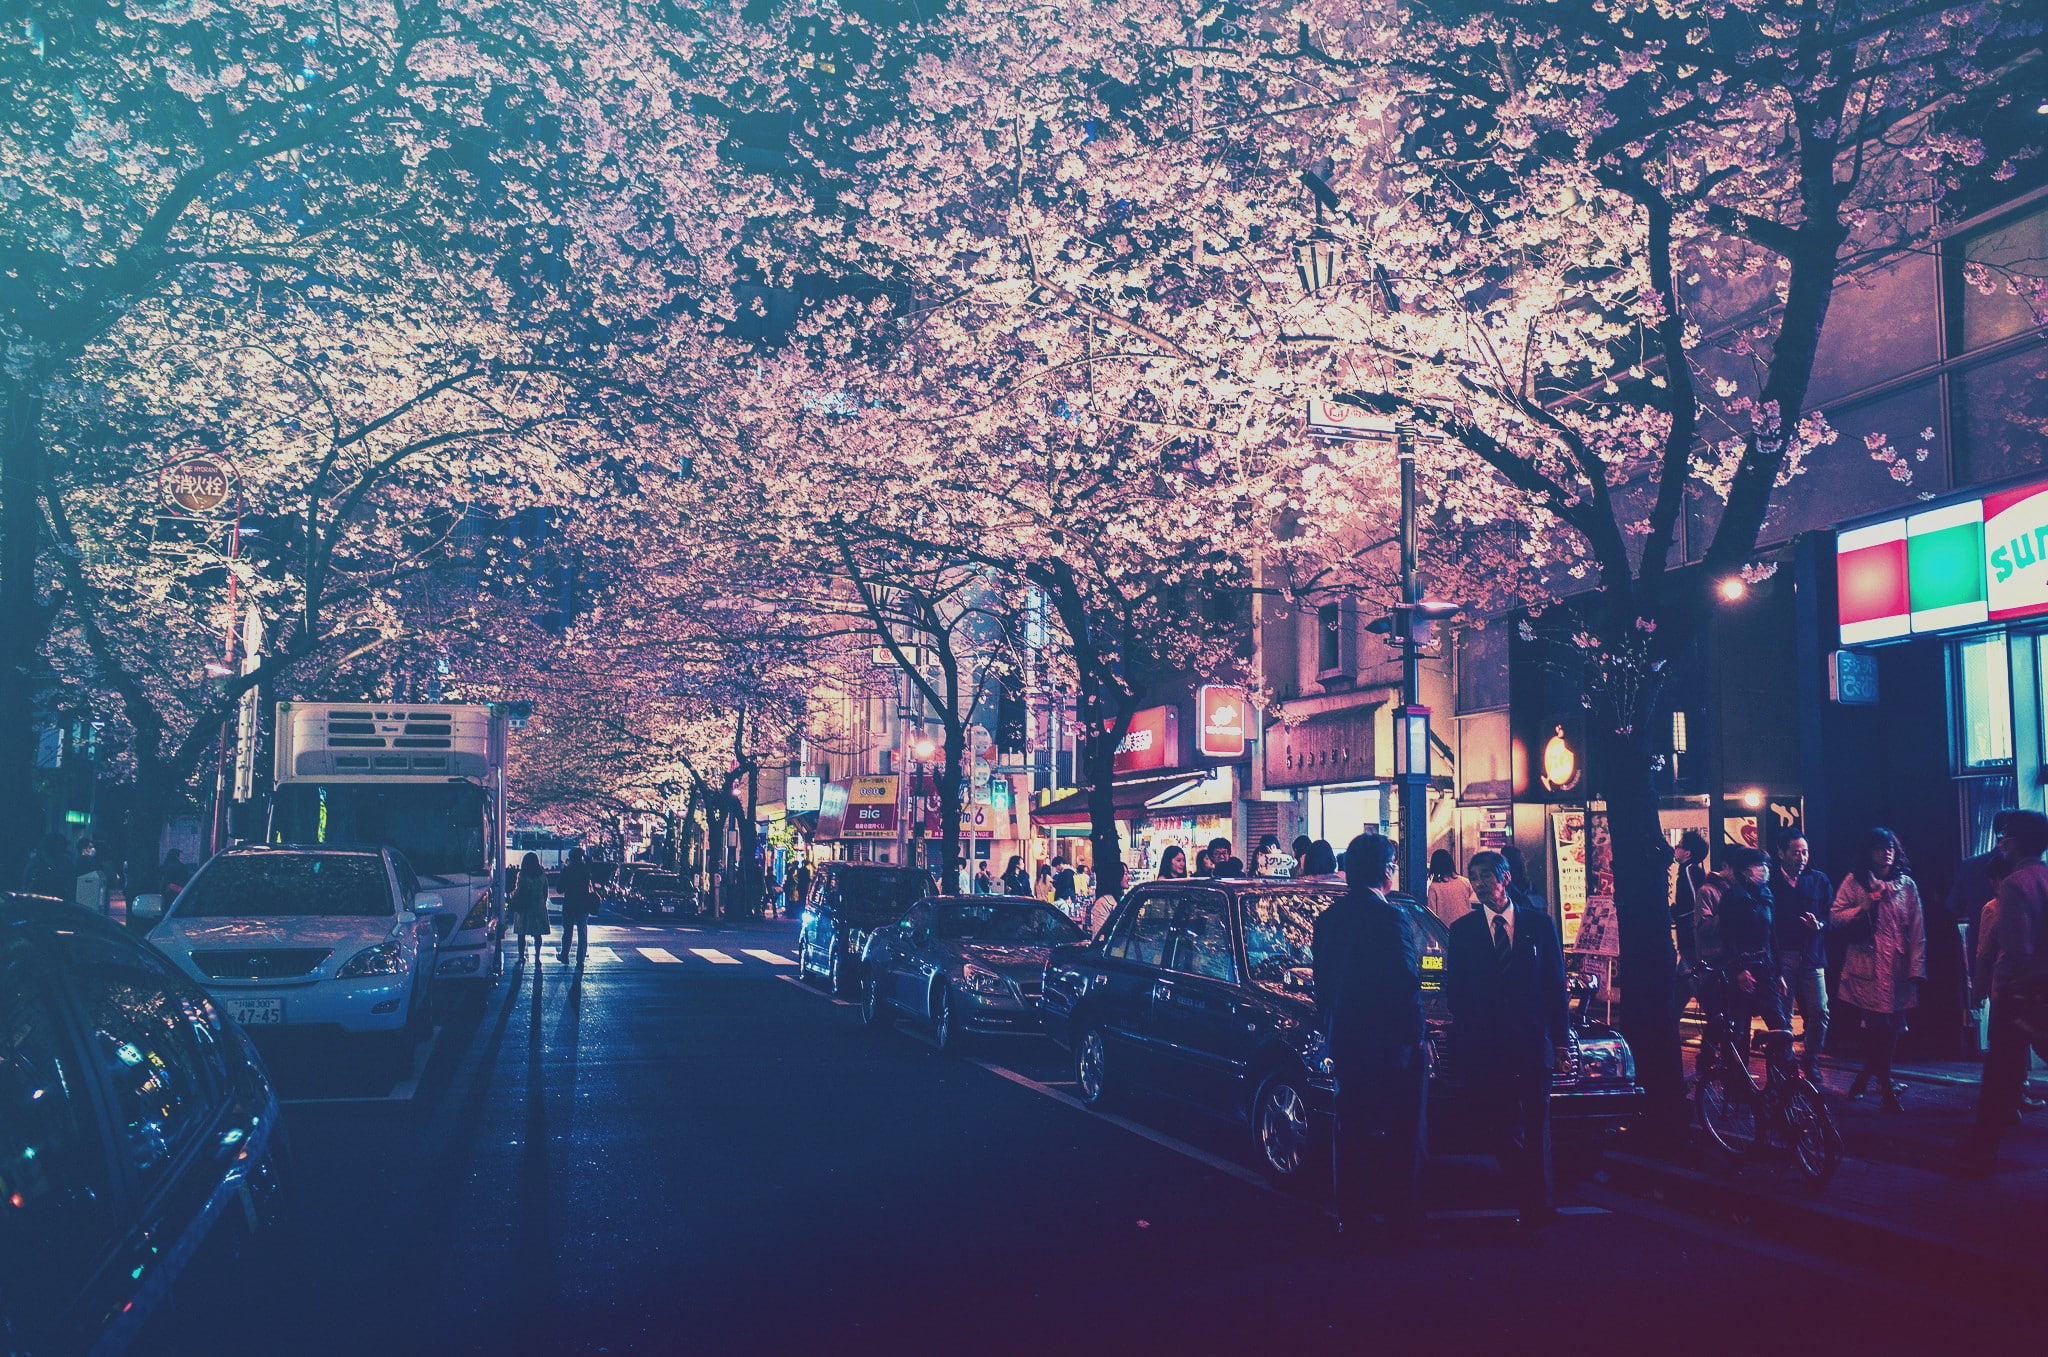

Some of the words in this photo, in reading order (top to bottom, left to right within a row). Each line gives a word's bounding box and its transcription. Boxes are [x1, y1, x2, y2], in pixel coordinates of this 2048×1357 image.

[174, 474, 224, 497] 消火栓
[237, 1009, 280, 1024] 47-45
